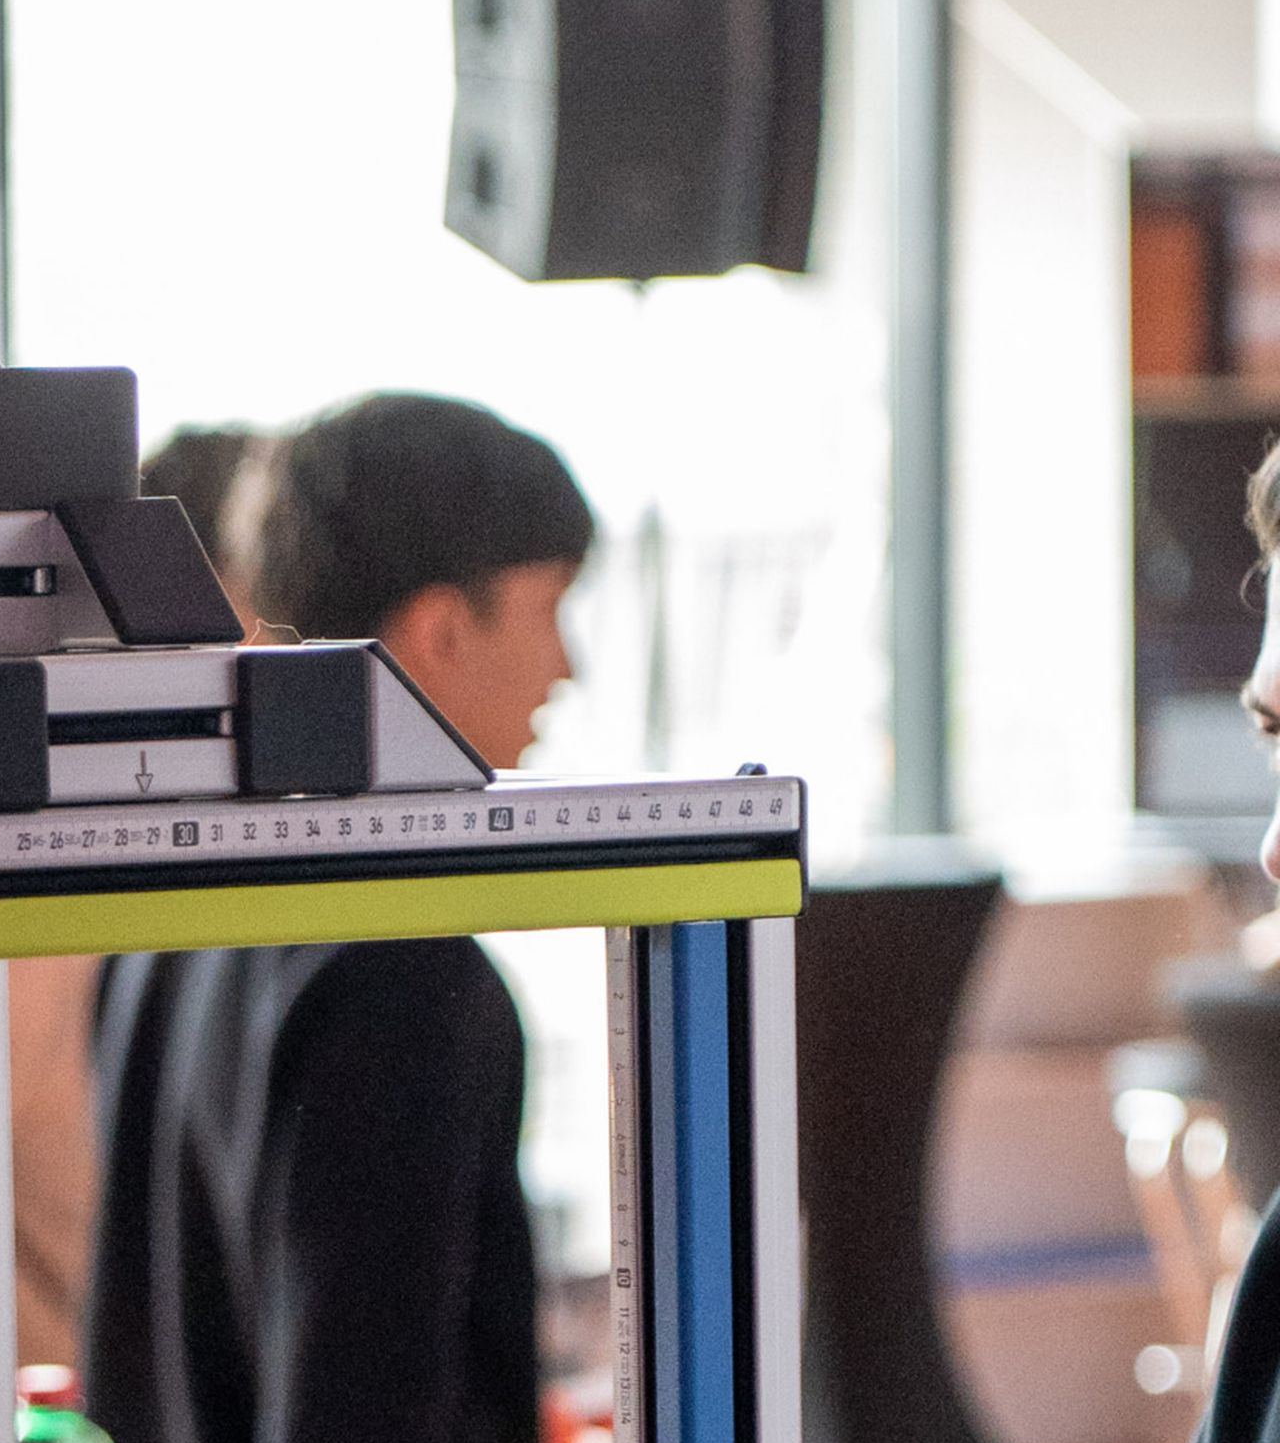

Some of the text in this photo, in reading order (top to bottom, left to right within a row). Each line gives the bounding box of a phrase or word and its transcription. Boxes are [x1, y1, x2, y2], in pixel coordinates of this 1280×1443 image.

[17, 833, 31, 850] 25
[50, 831, 64, 849] 26
[82, 830, 96, 847] 27
[115, 829, 128, 846] 28
[147, 827, 160, 844] 29
[176, 824, 196, 845] 30
[211, 824, 223, 841] 31
[243, 822, 256, 839] 32
[275, 821, 288, 838] 33
[306, 820, 320, 837] 34
[338, 818, 351, 835] 35
[369, 817, 383, 834] 36
[401, 815, 414, 832] 37
[432, 814, 446, 831] 38
[463, 812, 476, 830] 39
[492, 809, 511, 830] 40
[525, 809, 536, 826] 41
[556, 808, 569, 825] 42
[587, 806, 600, 823] 43
[617, 804, 630, 821] 44
[648, 803, 661, 820] 45
[679, 802, 692, 819] 46
[709, 800, 721, 817] 47
[739, 799, 752, 816] 48
[770, 798, 782, 815] 49
[620, 1308, 630, 1317] 11
[620, 1342, 630, 1354] 12
[620, 1378, 631, 1389] 13
[621, 1412, 631, 1424] 14
